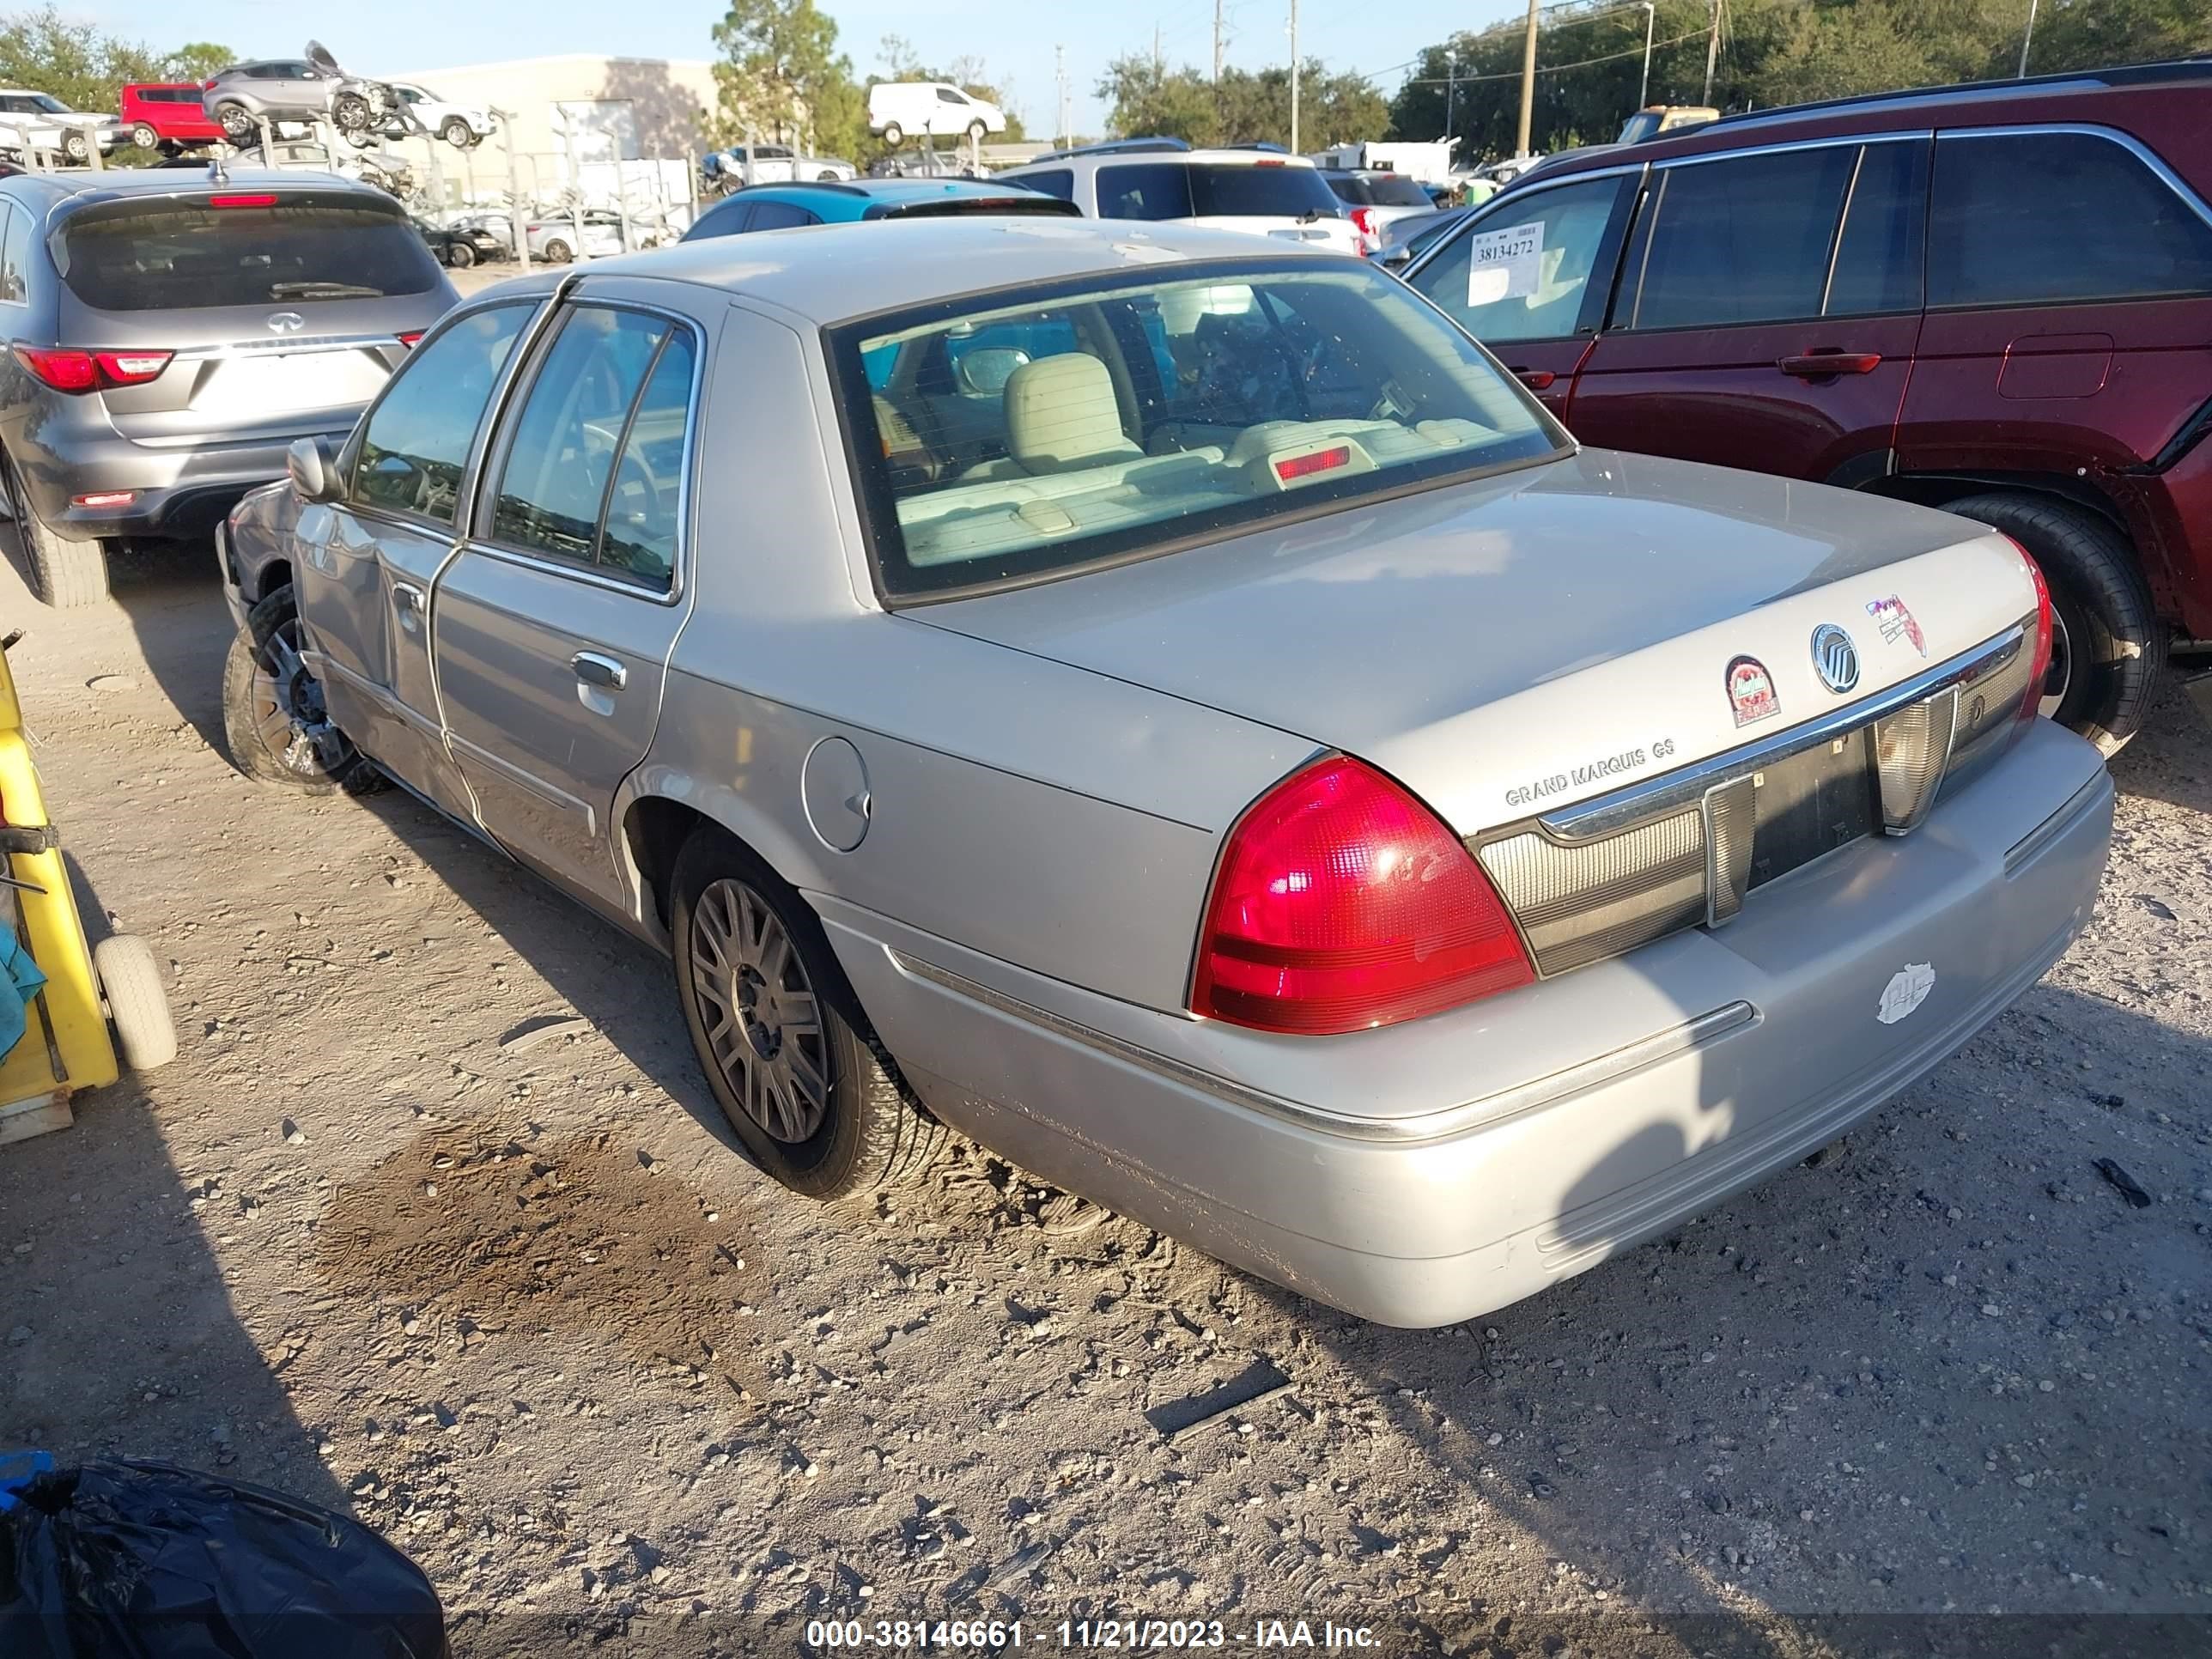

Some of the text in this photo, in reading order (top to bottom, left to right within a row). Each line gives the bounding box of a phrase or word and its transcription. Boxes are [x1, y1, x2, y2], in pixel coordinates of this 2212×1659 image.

[1478, 240, 1533, 263] 38134272
[1505, 738, 1675, 806] GRAND MARQUIS GS
